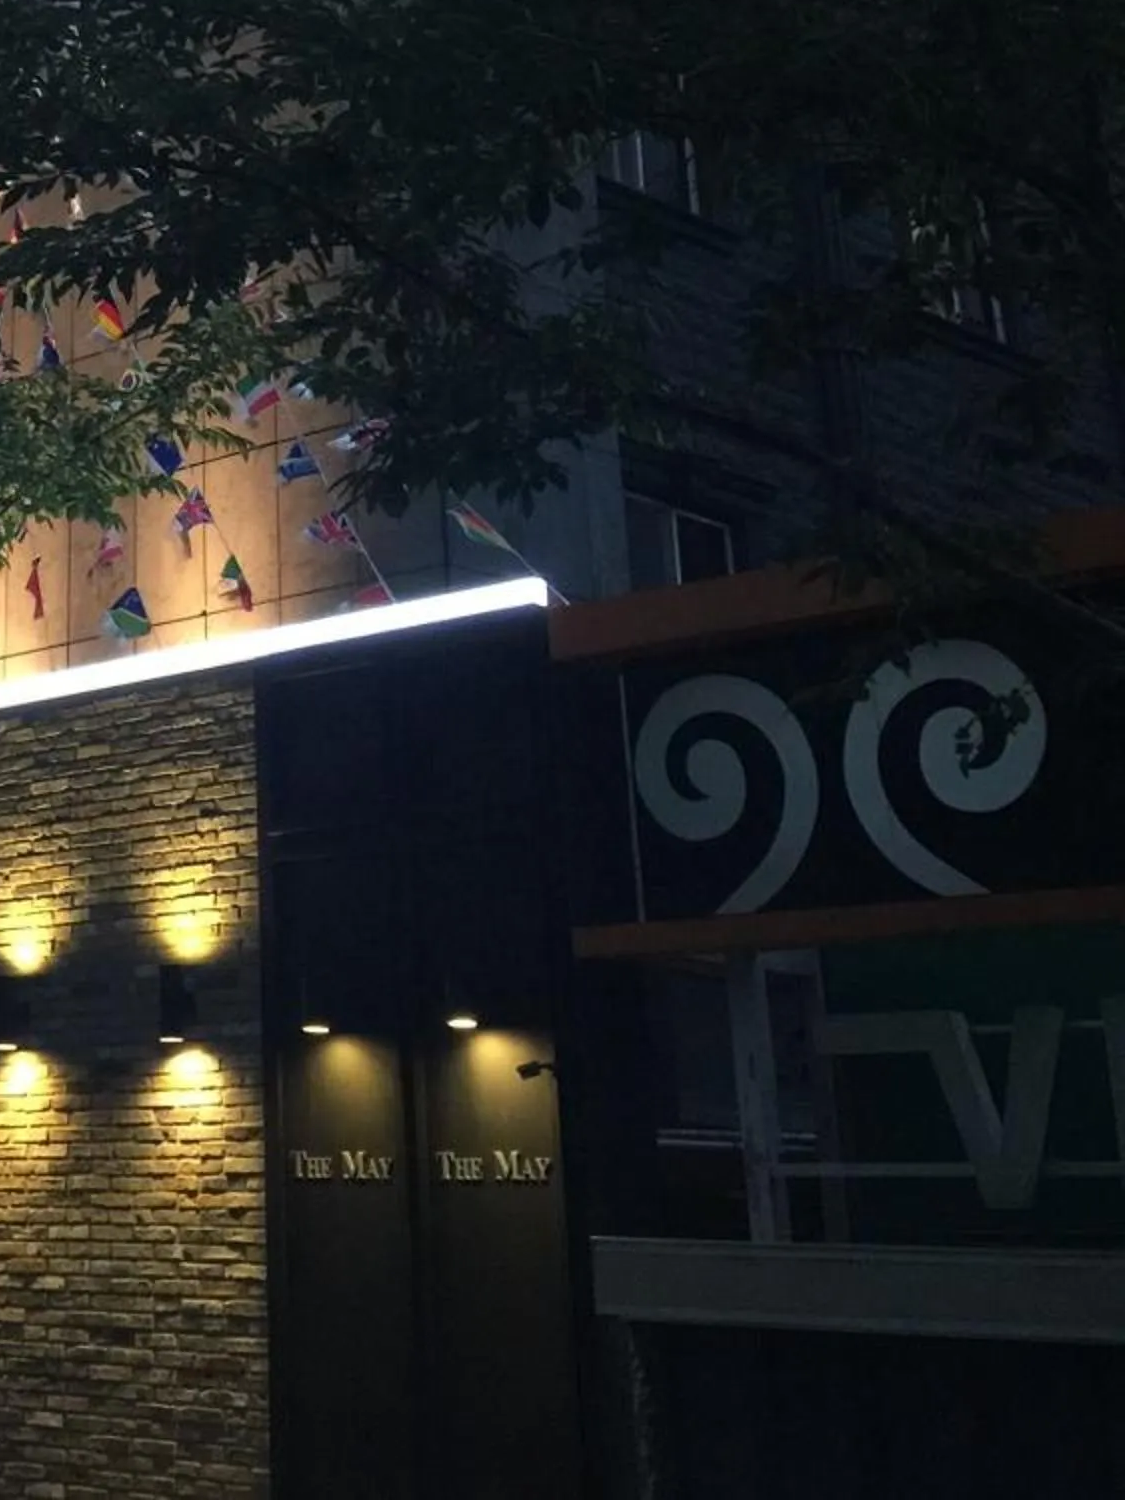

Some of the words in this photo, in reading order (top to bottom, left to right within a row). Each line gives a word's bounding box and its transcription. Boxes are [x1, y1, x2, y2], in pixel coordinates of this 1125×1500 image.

[289, 1150, 333, 1181] THE
[340, 1149, 394, 1181] MAY
[435, 1150, 485, 1182] THE
[492, 1149, 552, 1183] MAY
